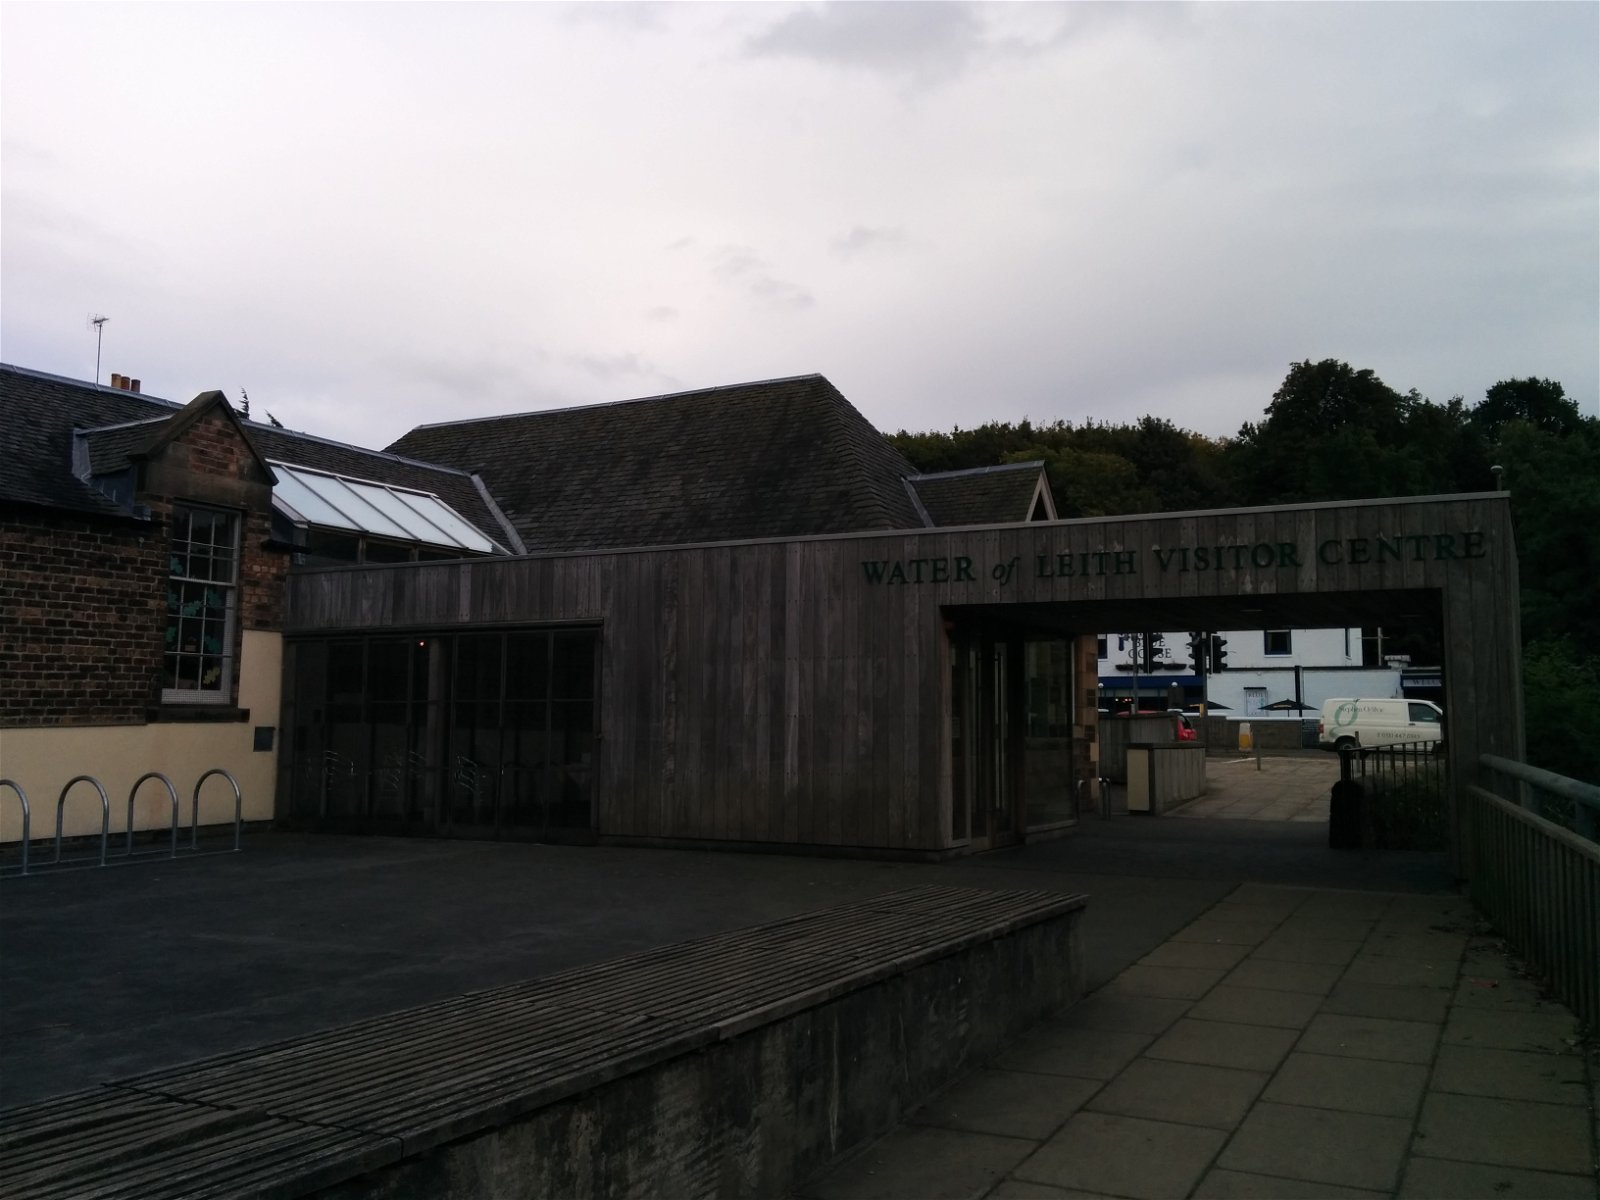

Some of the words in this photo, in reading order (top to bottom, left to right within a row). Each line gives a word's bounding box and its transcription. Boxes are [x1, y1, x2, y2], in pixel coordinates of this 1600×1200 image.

[861, 555, 977, 586] WATER
[992, 556, 1021, 586] of
[1037, 550, 1138, 579] LEITH
[1153, 542, 1303, 573] VISITOR
[1319, 531, 1487, 566] CENTRE
